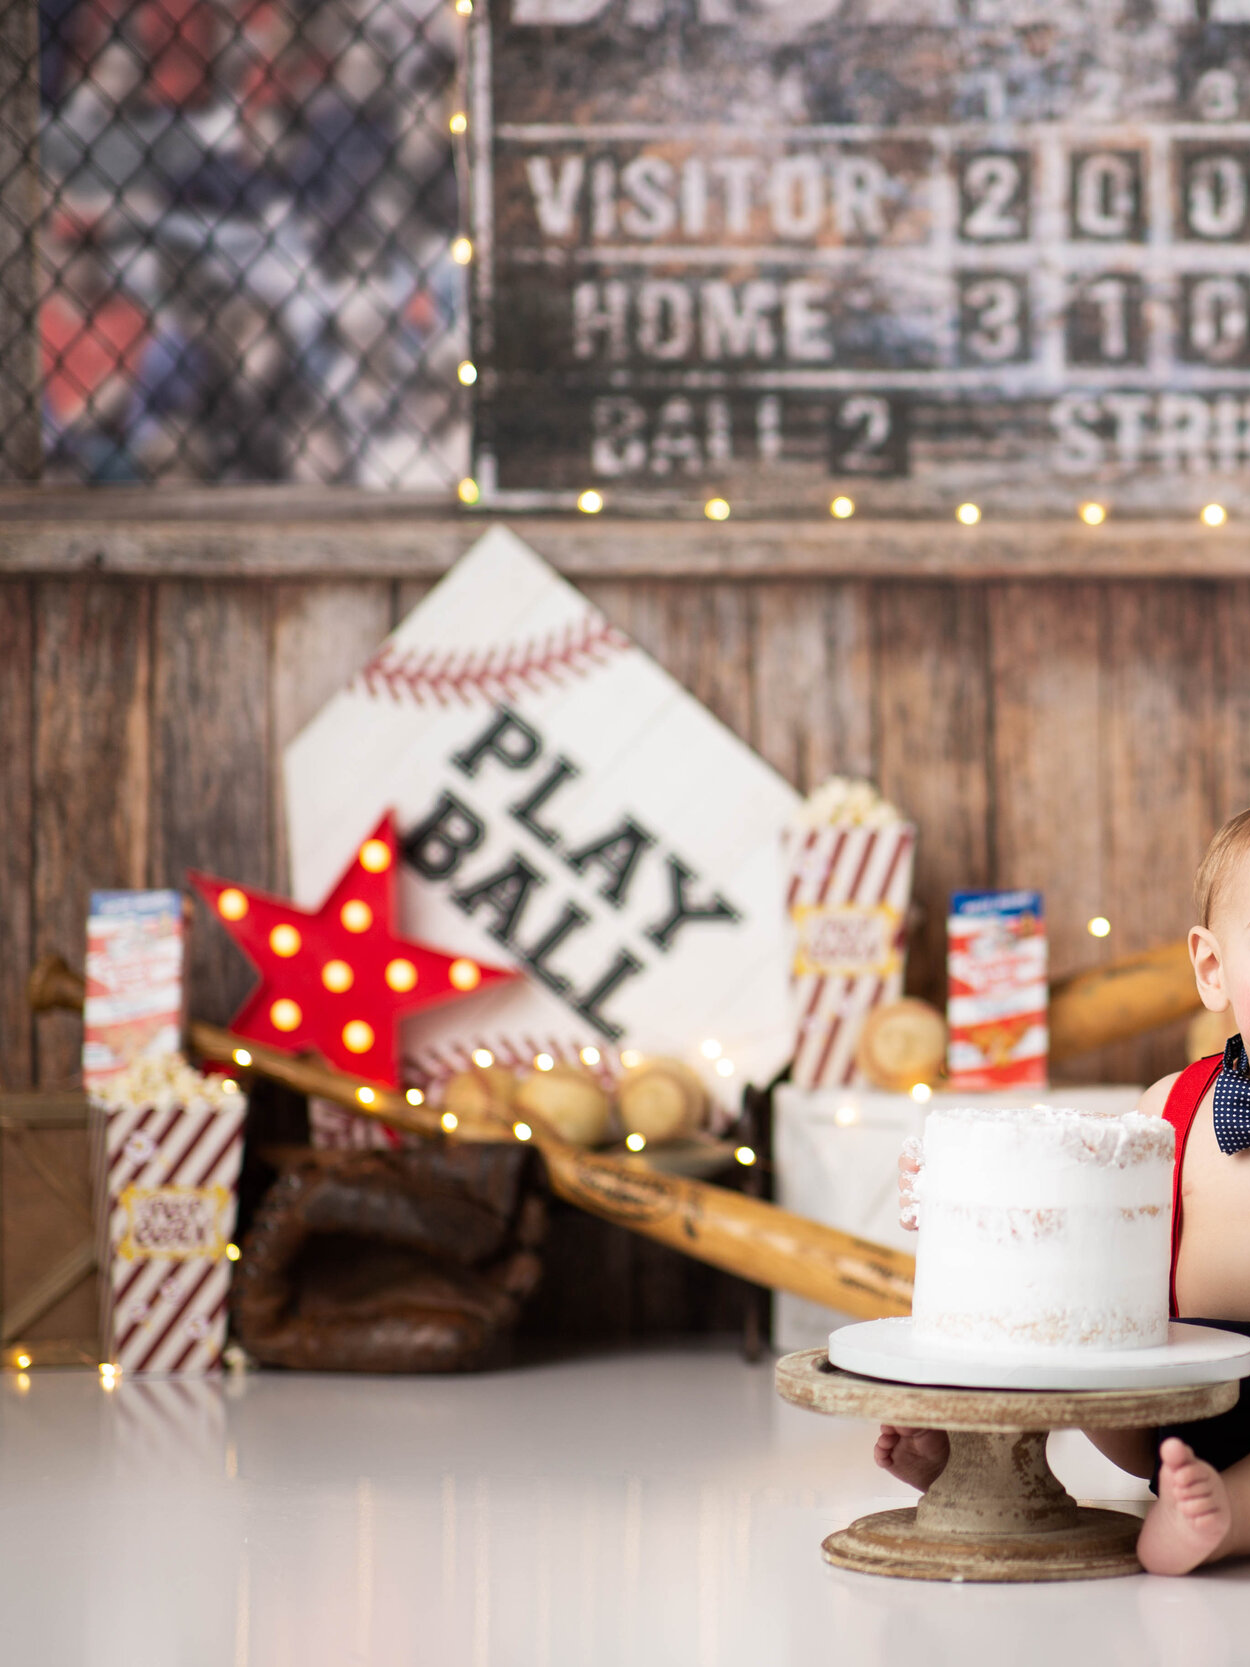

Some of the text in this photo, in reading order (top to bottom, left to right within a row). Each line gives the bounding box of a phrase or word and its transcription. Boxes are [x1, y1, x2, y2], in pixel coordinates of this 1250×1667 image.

[526, 154, 888, 239] VISITOR
[963, 154, 1023, 239] 2
[1188, 153, 1247, 238] 0
[572, 278, 834, 361] HOME
[962, 278, 1021, 361] 3
[1085, 279, 1127, 359] 1
[1188, 278, 1247, 361] 0
[839, 393, 894, 472] 2
[449, 703, 743, 953] PLAY
[399, 788, 645, 1044] BALL
